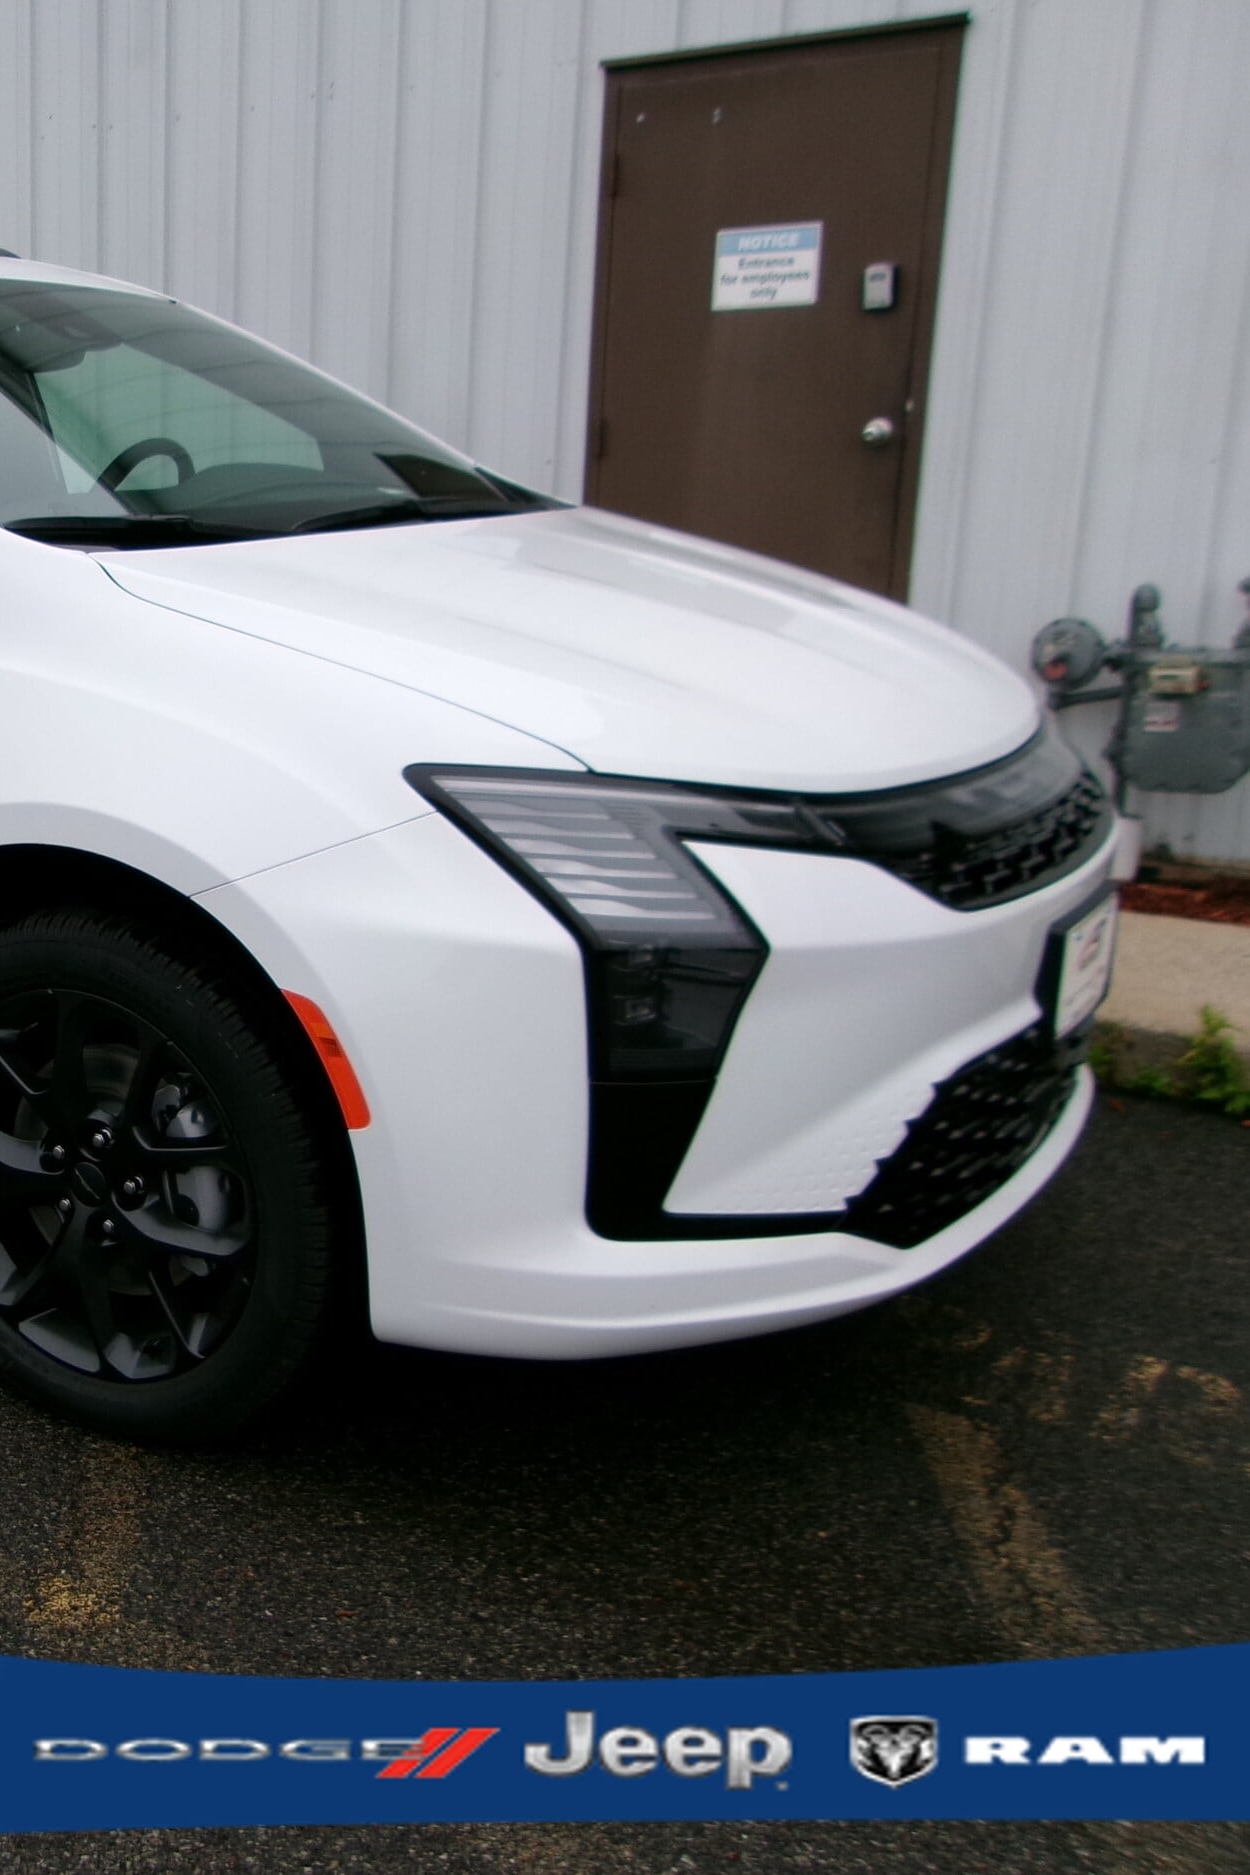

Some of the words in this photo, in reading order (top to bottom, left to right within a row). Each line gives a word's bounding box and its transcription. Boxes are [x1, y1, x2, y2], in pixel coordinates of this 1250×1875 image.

[738, 233, 798, 251] NOTICE
[738, 257, 795, 270] Entrance
[720, 273, 738, 286] for
[742, 272, 809, 286] employees
[750, 288, 778, 300] only
